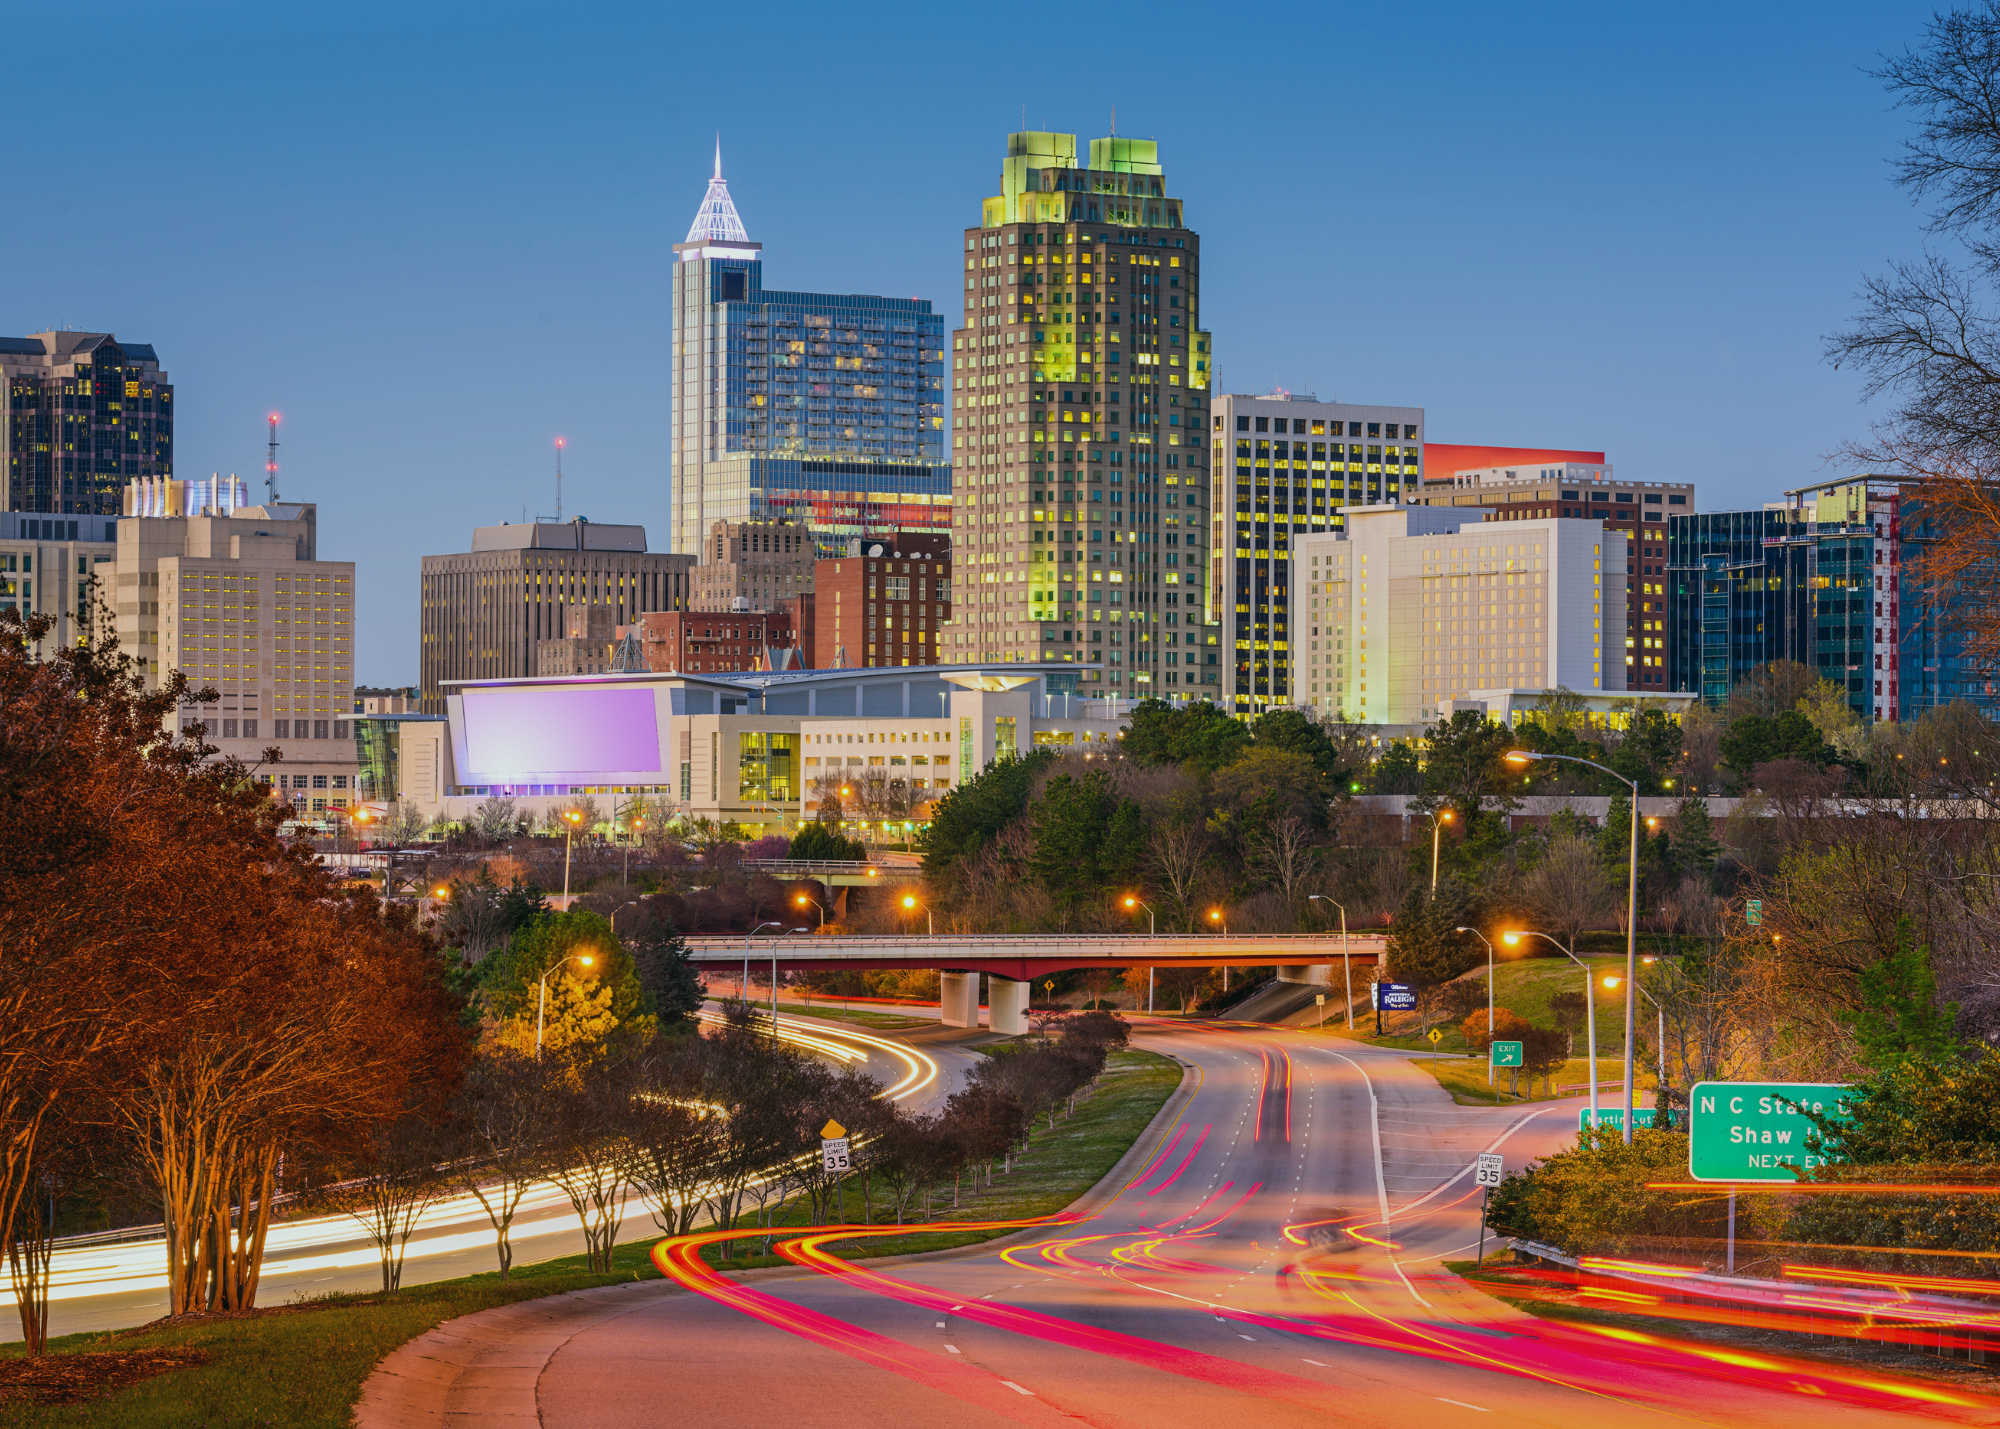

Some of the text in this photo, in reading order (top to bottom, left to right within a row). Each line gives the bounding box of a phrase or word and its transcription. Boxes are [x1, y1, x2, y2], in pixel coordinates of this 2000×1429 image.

[1701, 1096, 1715, 1114] N
[1729, 1096, 1743, 1114] C
[1758, 1097, 1824, 1115] State
[1730, 1126, 1792, 1144] Shaw
[827, 1156, 847, 1169] 35
[1748, 1155, 1844, 1169] NEXT EXT
[1479, 1170, 1499, 1182] 35
